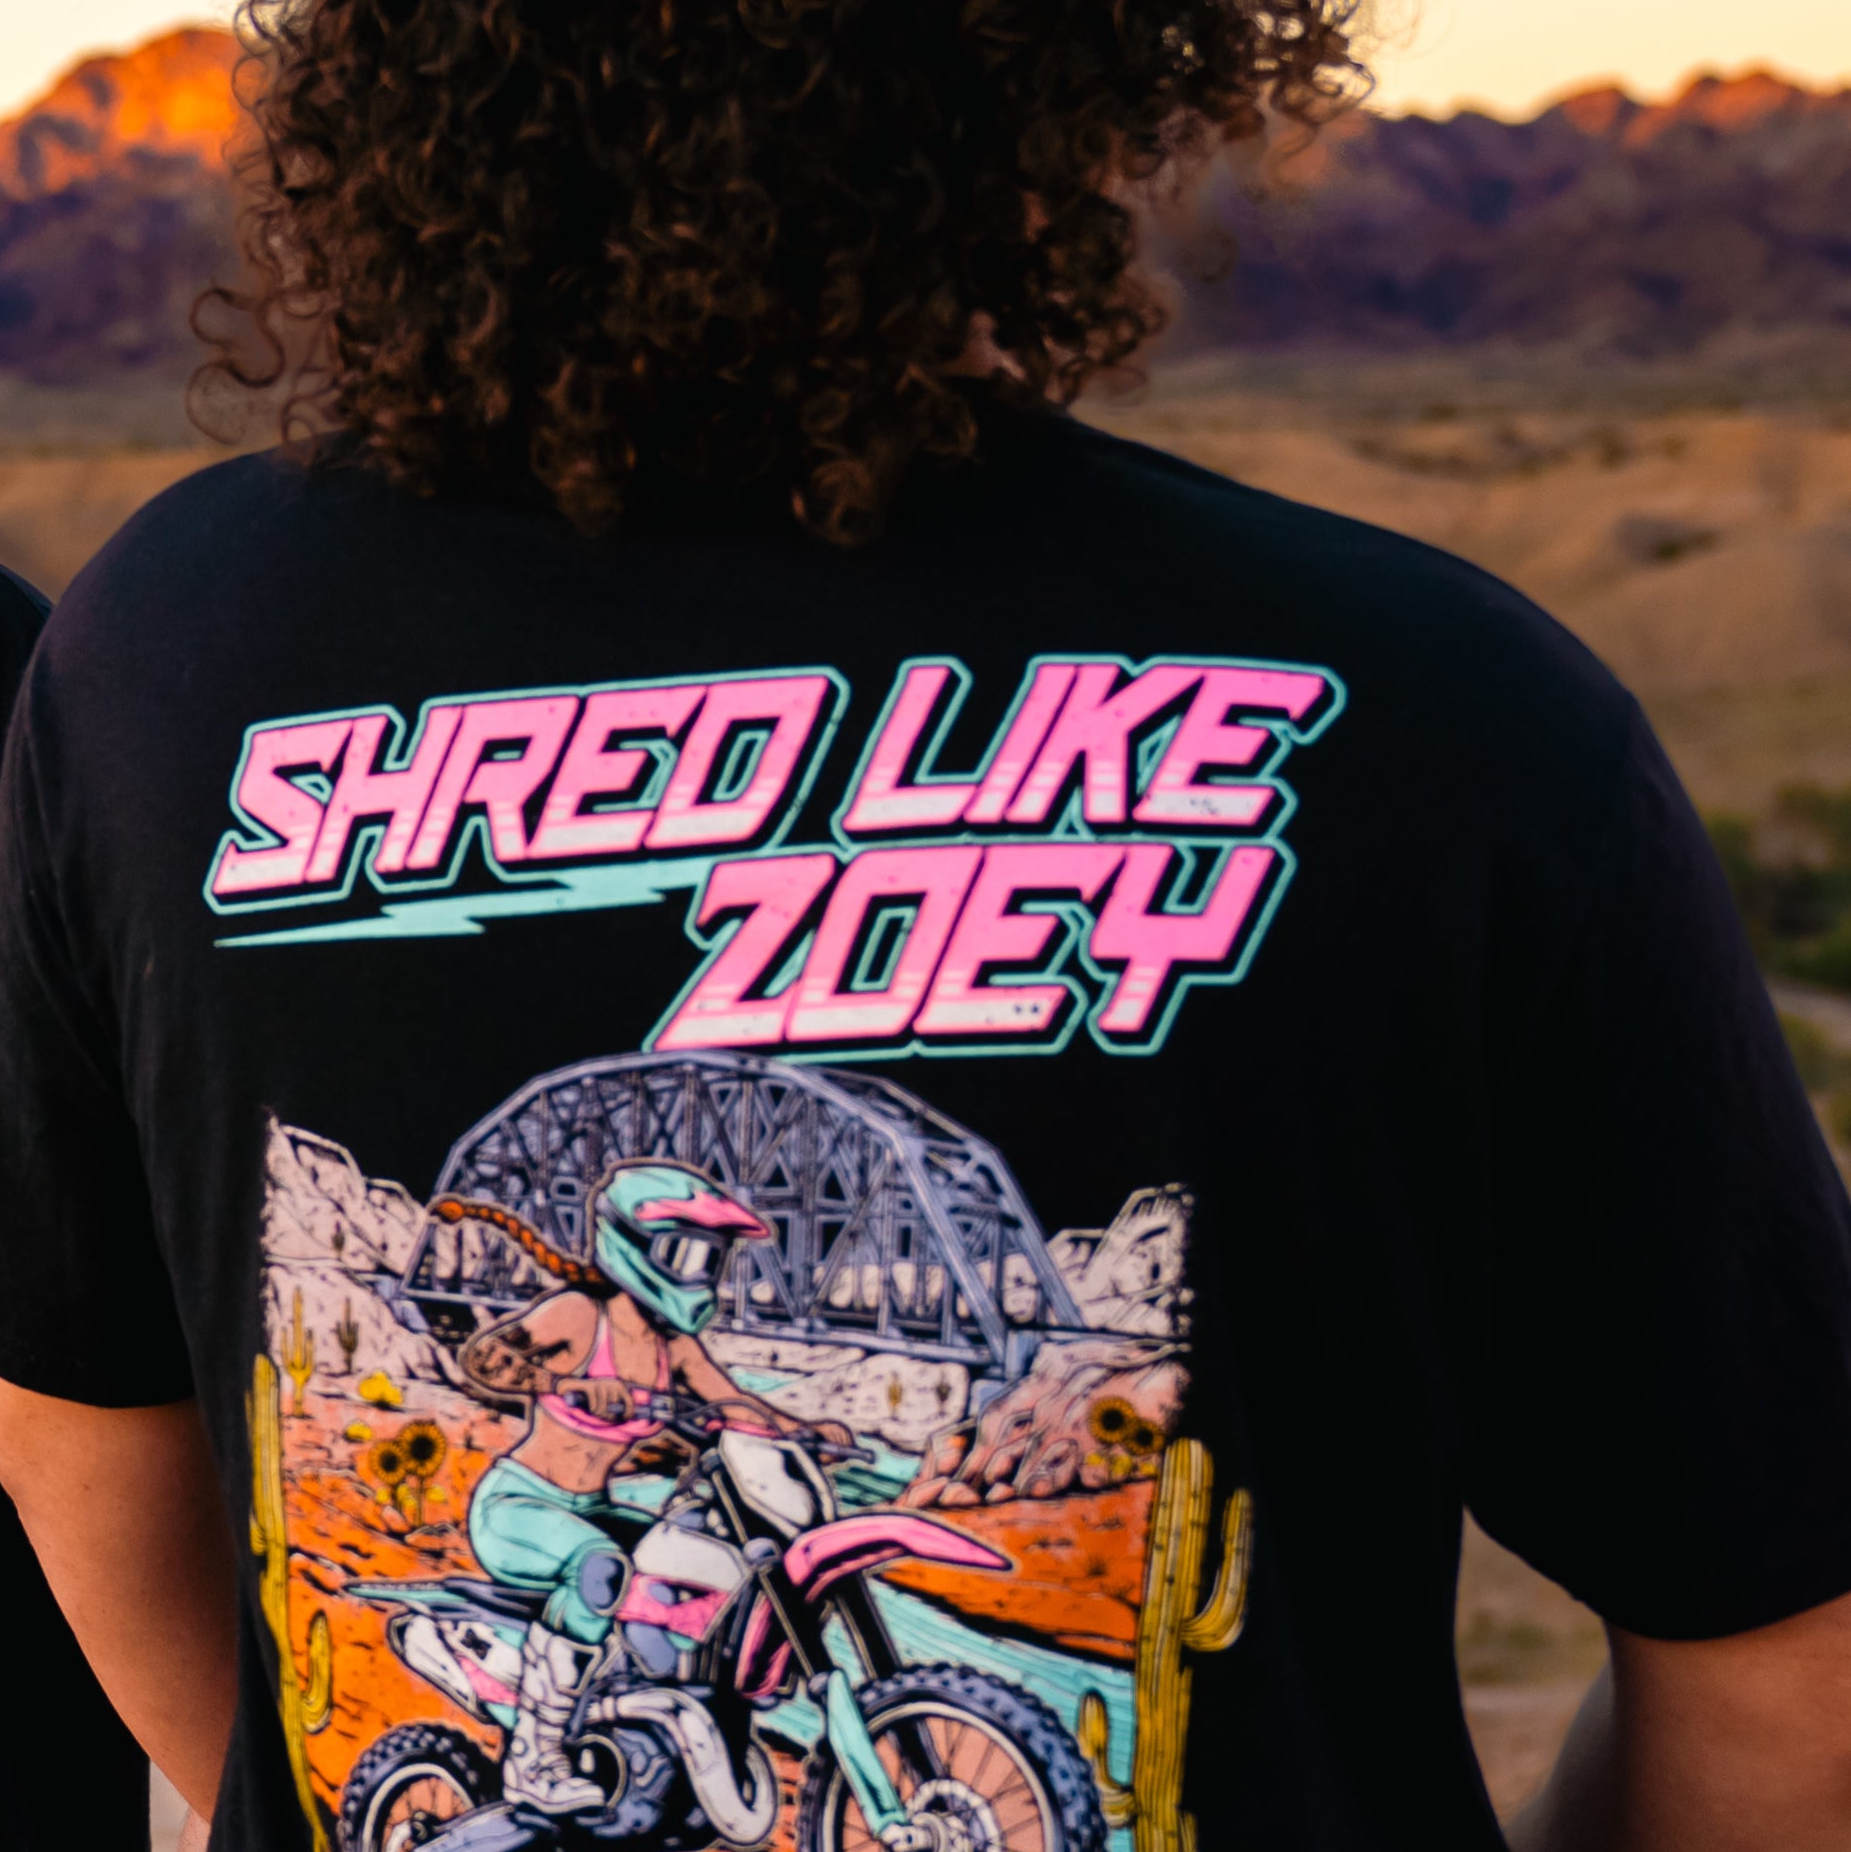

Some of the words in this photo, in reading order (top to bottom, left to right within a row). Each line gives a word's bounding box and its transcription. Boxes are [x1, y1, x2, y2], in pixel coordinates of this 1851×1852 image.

[208, 671, 840, 900] SHRED
[836, 657, 1336, 834] LIKE
[648, 839, 1280, 1054] ZOEY
